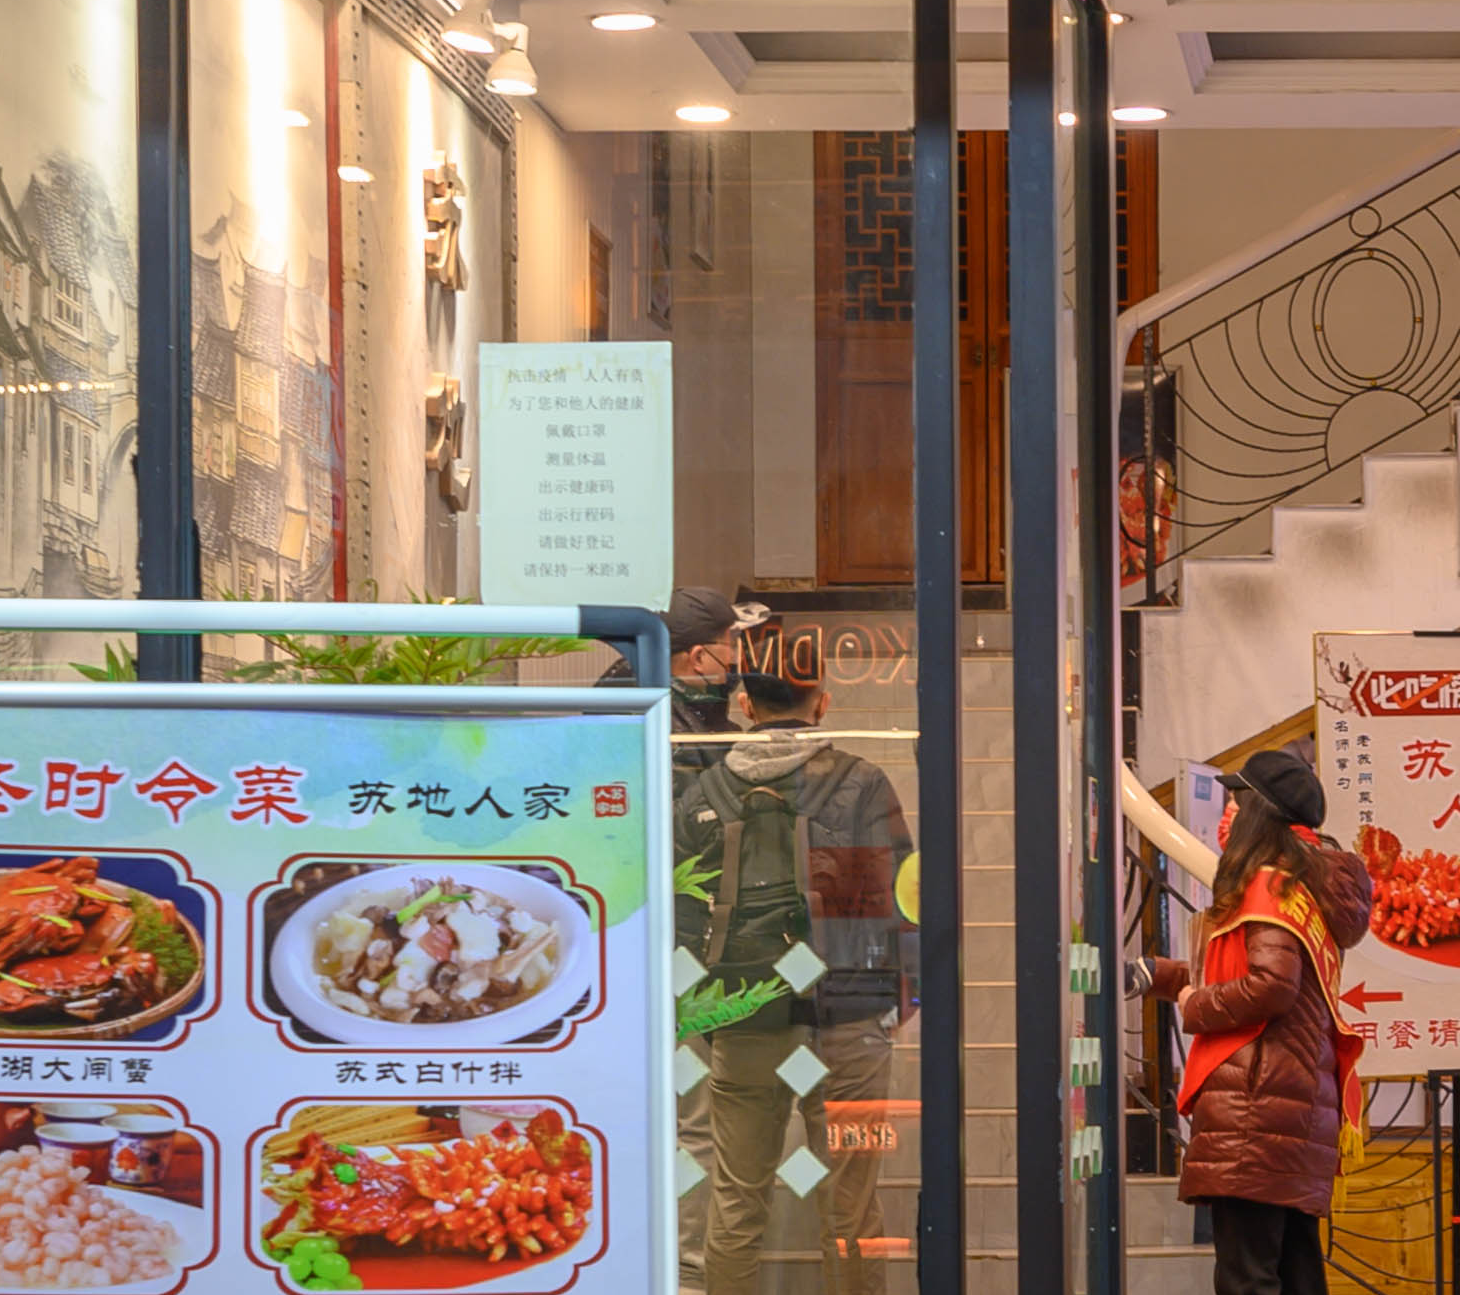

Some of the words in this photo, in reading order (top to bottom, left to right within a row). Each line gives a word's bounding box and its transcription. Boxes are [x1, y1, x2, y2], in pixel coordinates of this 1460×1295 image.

[584, 369, 644, 385] 人人有责
[508, 396, 645, 412] 为了您和他人的健康
[545, 423, 606, 440] 佩戴口罩
[545, 451, 606, 467] 测量体温
[538, 480, 615, 496] 出示健康码
[538, 507, 615, 523] 出示行程码
[538, 535, 615, 551] 请做好登记
[523, 562, 631, 578] 请保持一米距离
[1356, 735, 1373, 824] 老苏州菜馆
[349, 780, 572, 821] 苏地人家
[336, 1060, 523, 1087] 苏式白什拌
